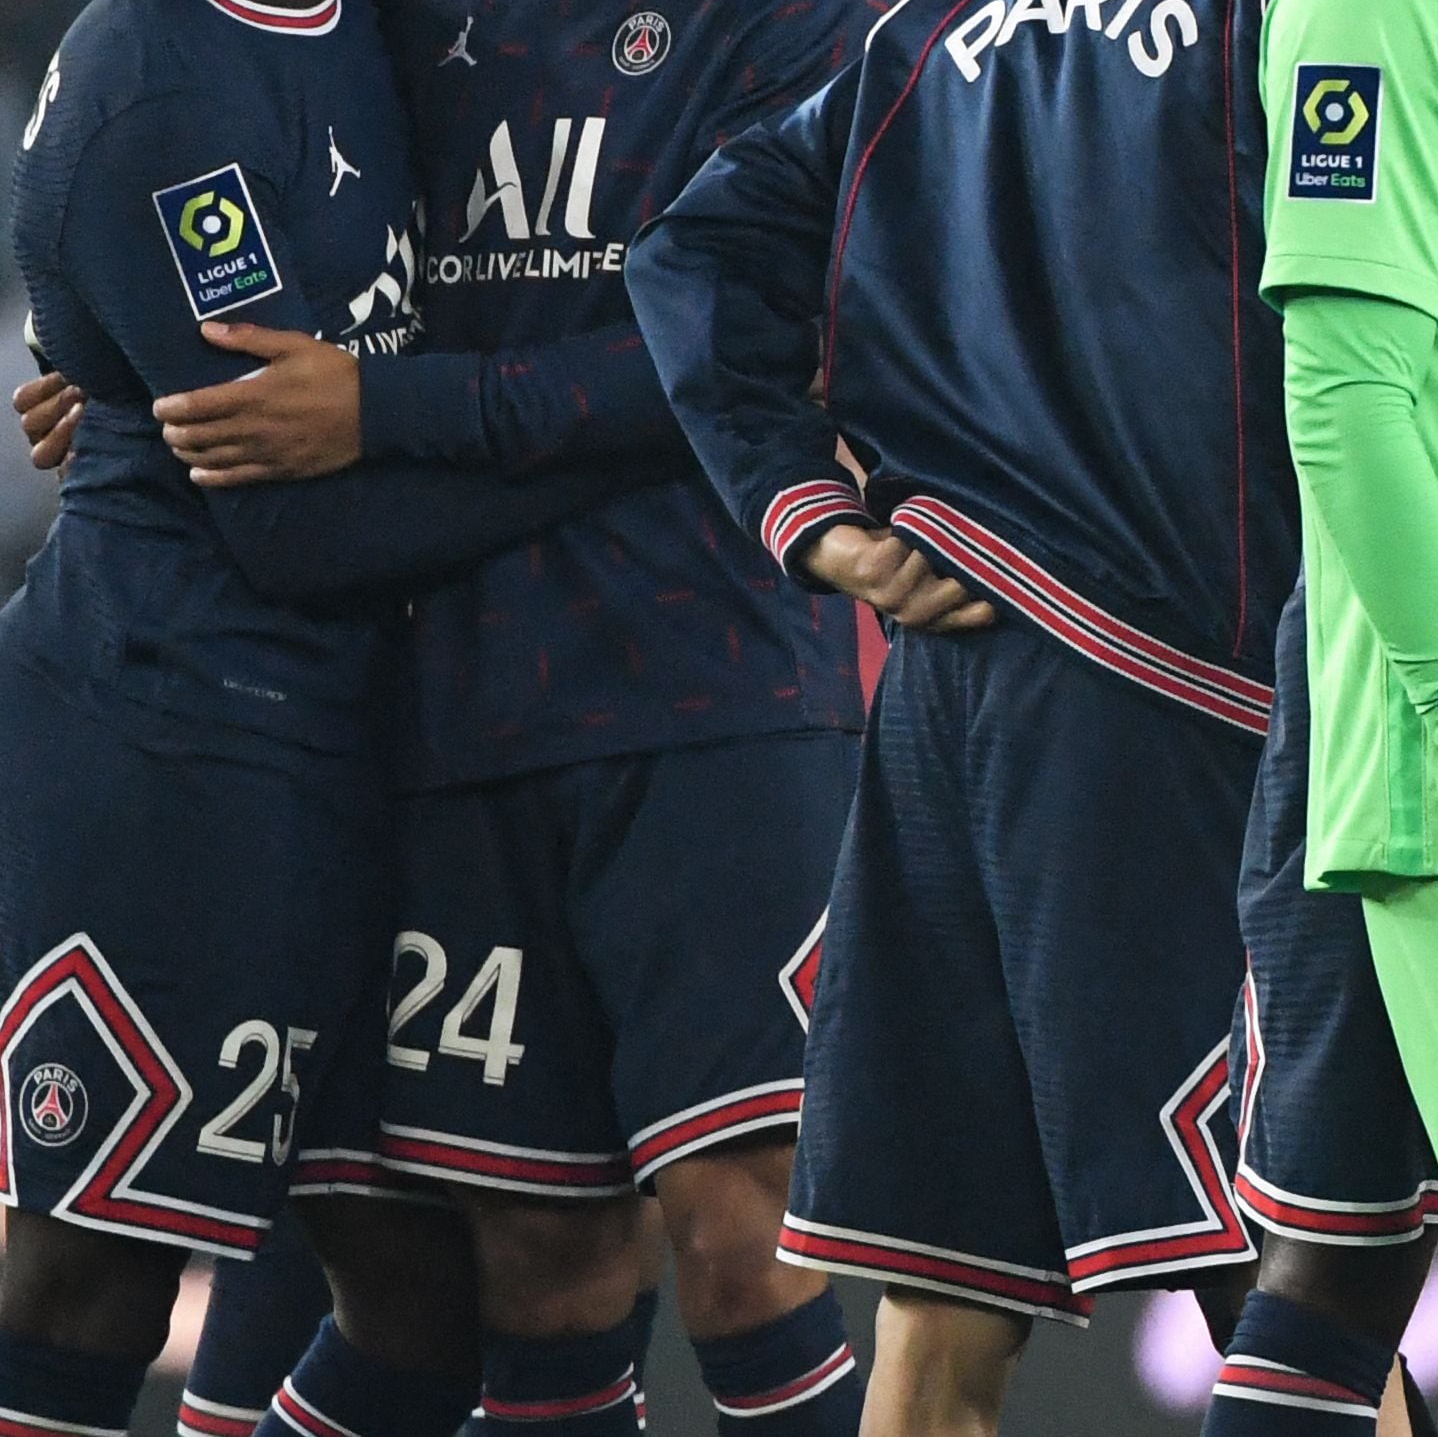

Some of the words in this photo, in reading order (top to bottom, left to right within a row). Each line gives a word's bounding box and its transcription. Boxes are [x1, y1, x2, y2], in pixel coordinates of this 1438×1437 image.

[627, 15, 665, 32] PARIS
[1301, 153, 1351, 168] LIGUE
[1354, 155, 1363, 169] 1
[1295, 172, 1328, 186] Uber
[1330, 173, 1366, 188] Eats
[198, 257, 248, 284] LIGUE
[248, 252, 258, 265] 1
[199, 282, 233, 302] Uber
[234, 270, 268, 290] Eats
[387, 929, 526, 1087] 24
[33, 1068, 79, 1093] PARIS
[196, 1018, 319, 1167] 25
